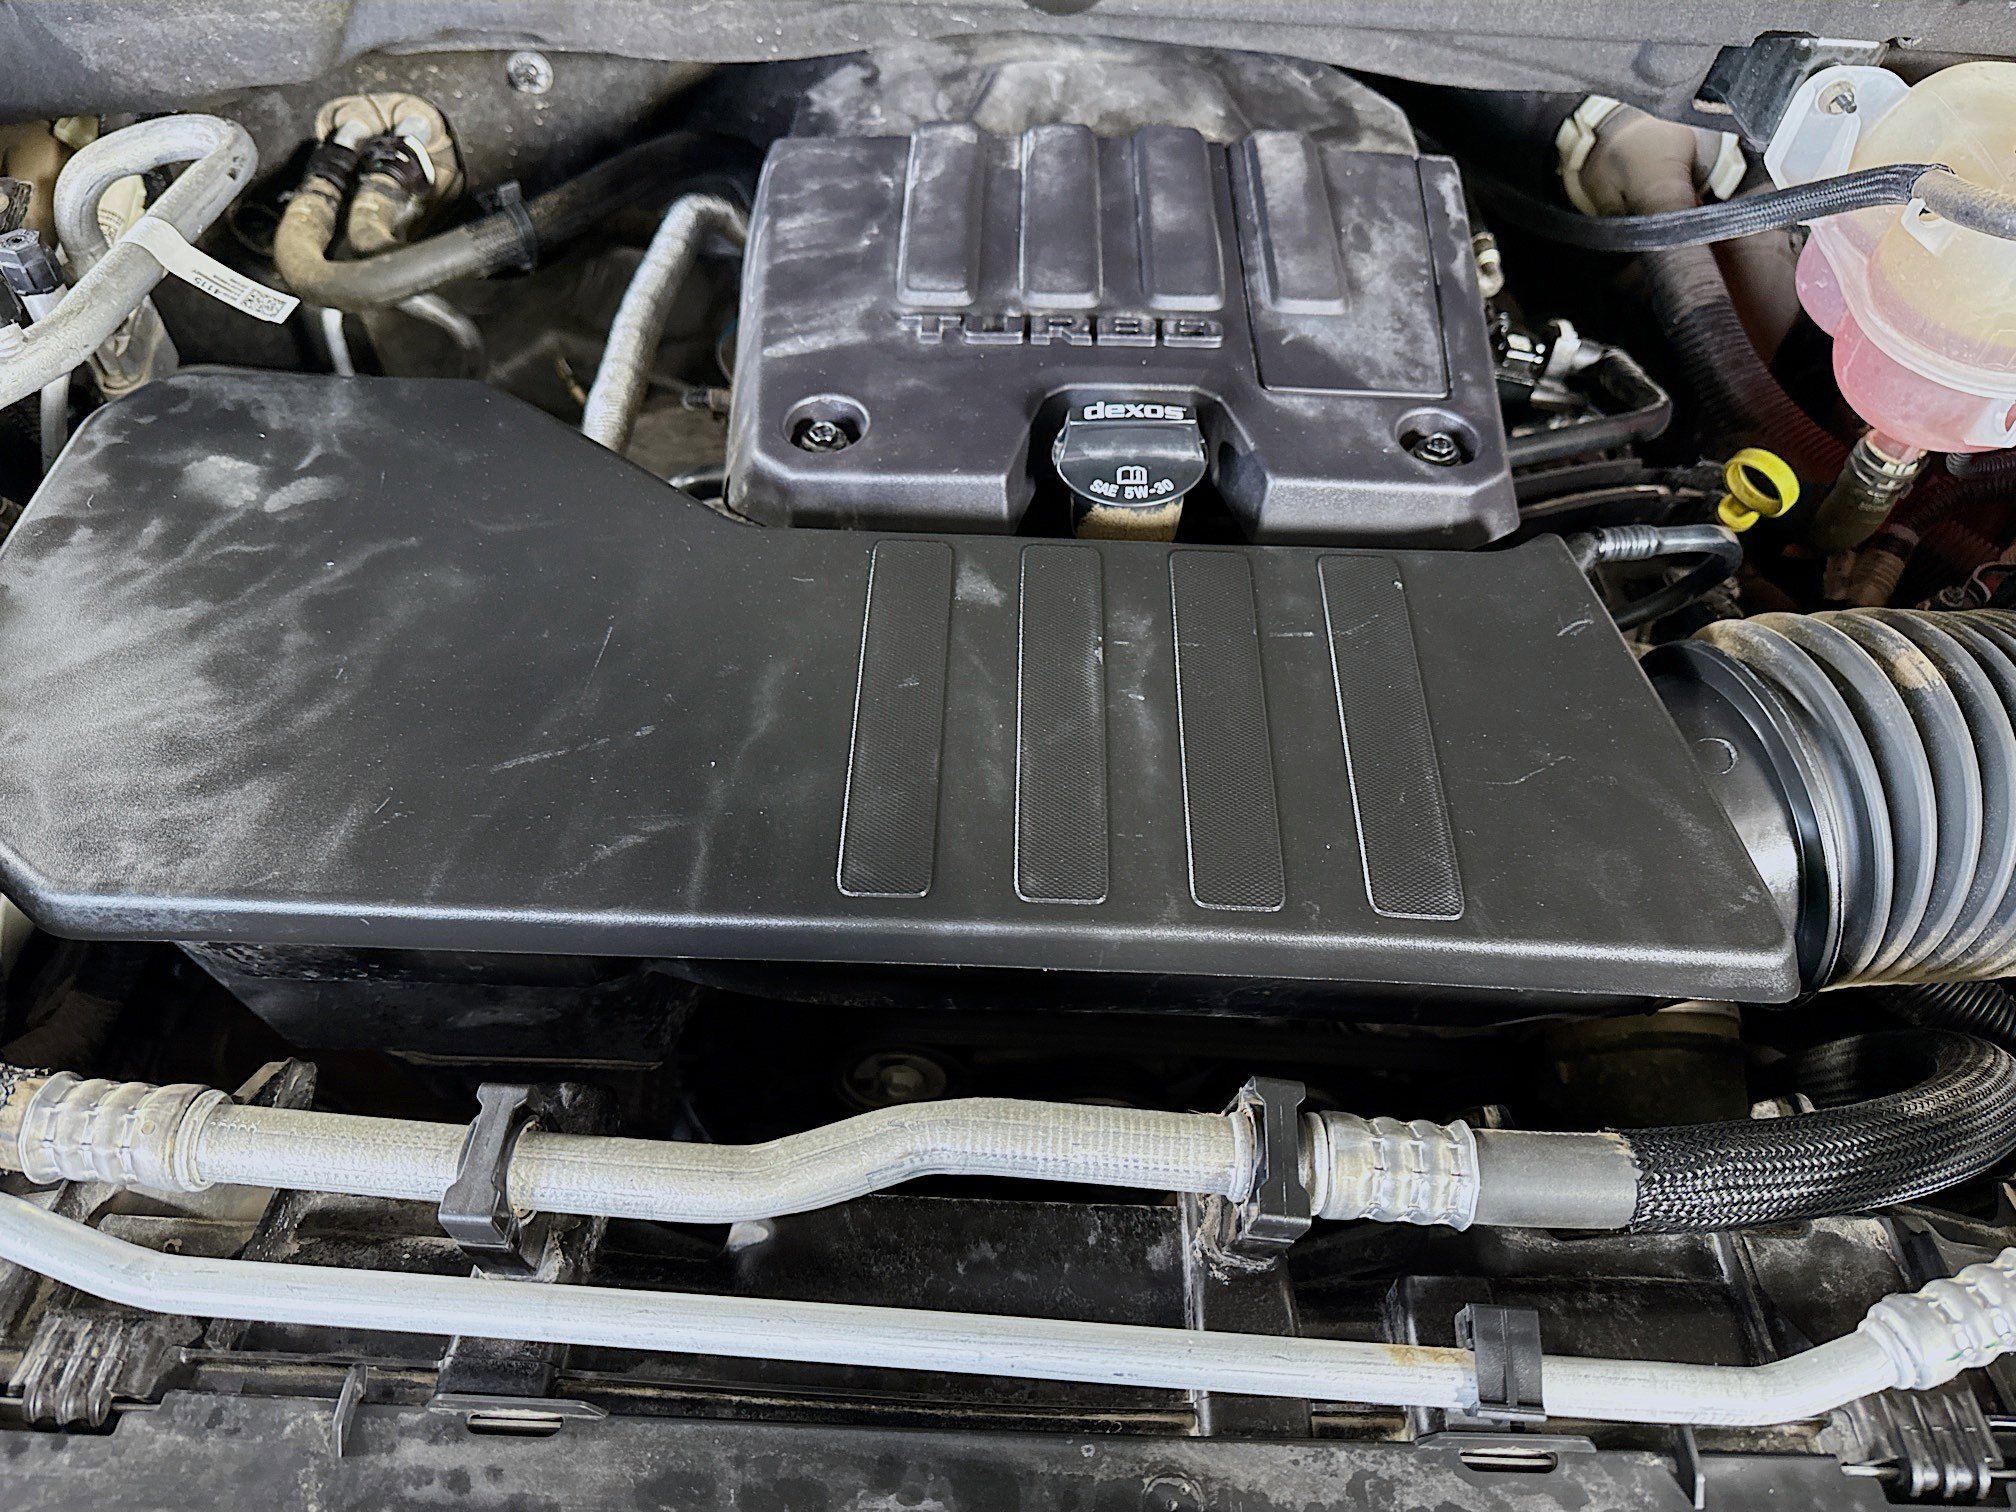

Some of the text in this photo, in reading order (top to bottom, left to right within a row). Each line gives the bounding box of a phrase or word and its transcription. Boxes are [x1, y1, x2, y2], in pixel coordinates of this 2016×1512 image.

[899, 312, 1222, 348] TURBO
[1083, 401, 1187, 420] dexos
[1089, 478, 1175, 499] SAE 5W-30
